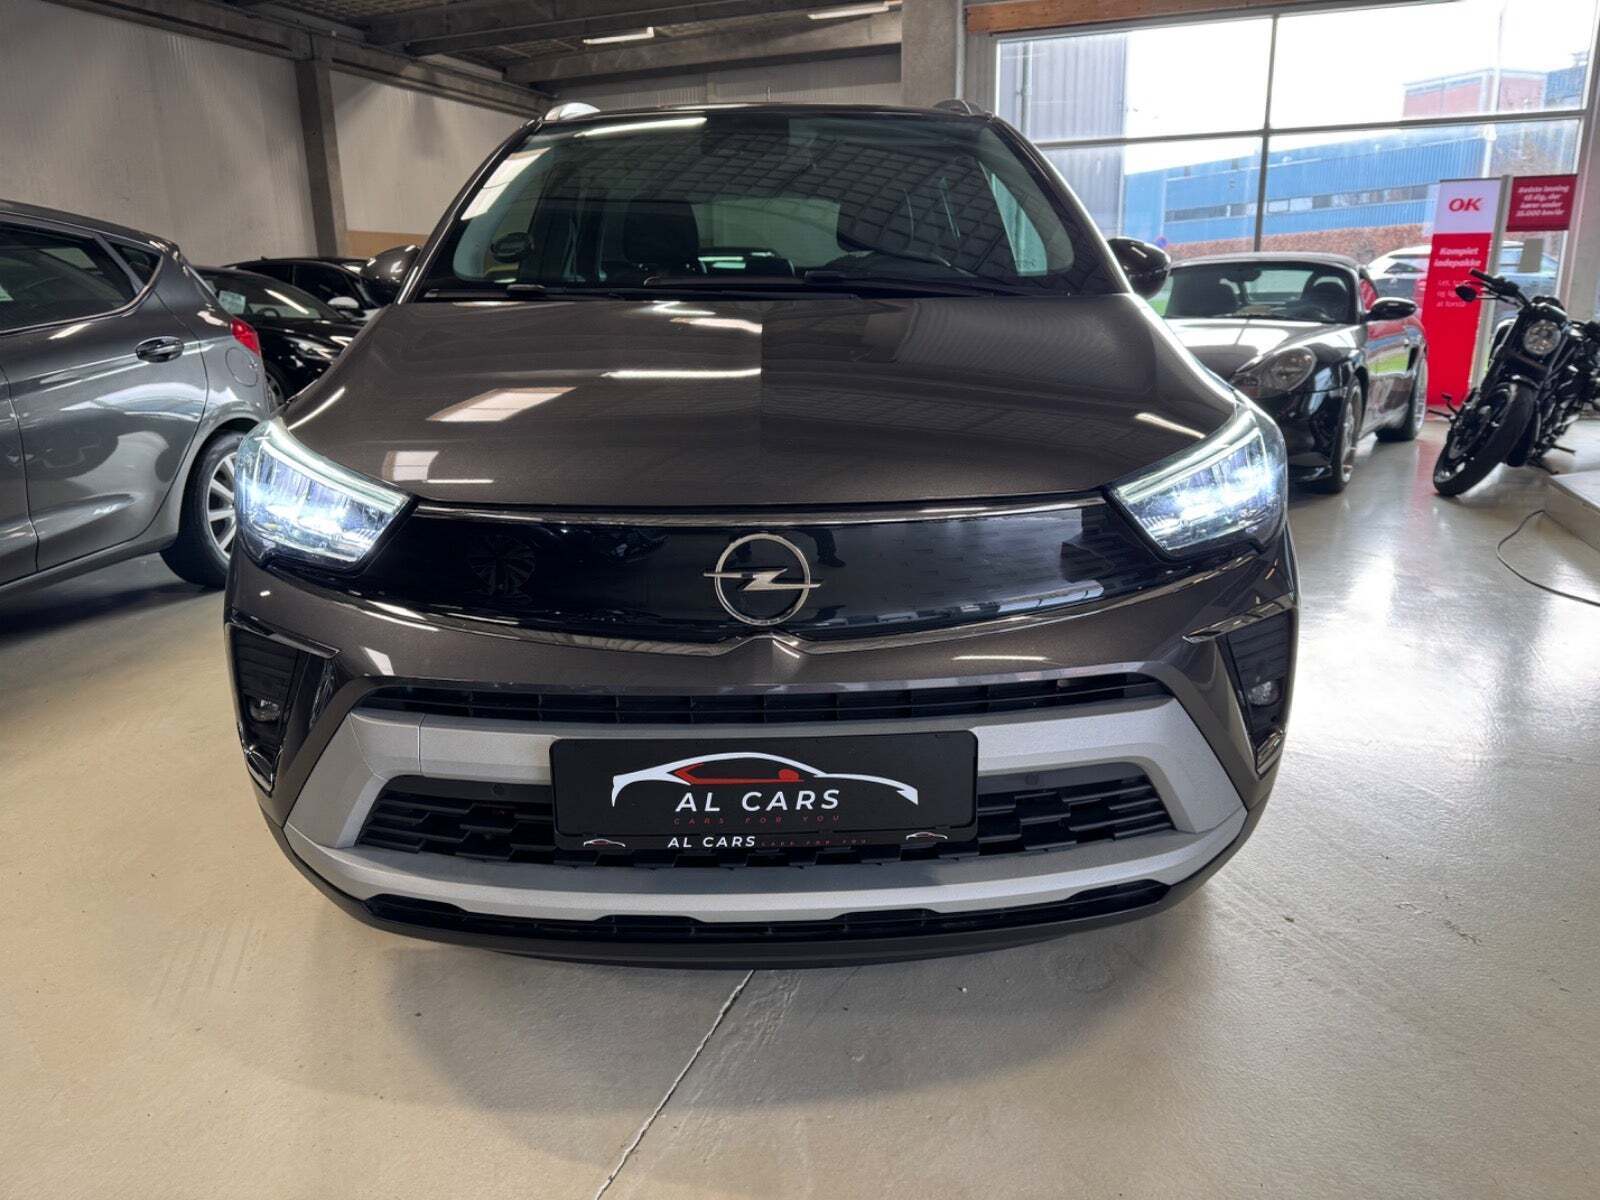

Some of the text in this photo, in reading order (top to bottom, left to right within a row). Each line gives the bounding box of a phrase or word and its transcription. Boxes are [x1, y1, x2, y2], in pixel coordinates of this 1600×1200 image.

[1449, 198, 1483, 211] OK
[1439, 247, 1479, 257] Komplet
[1433, 258, 1482, 269] ladepakke
[675, 789, 840, 812] AL CARS
[673, 815, 840, 825] CARS FOR YOU
[667, 837, 693, 848] AL
[702, 836, 756, 848] CARS
